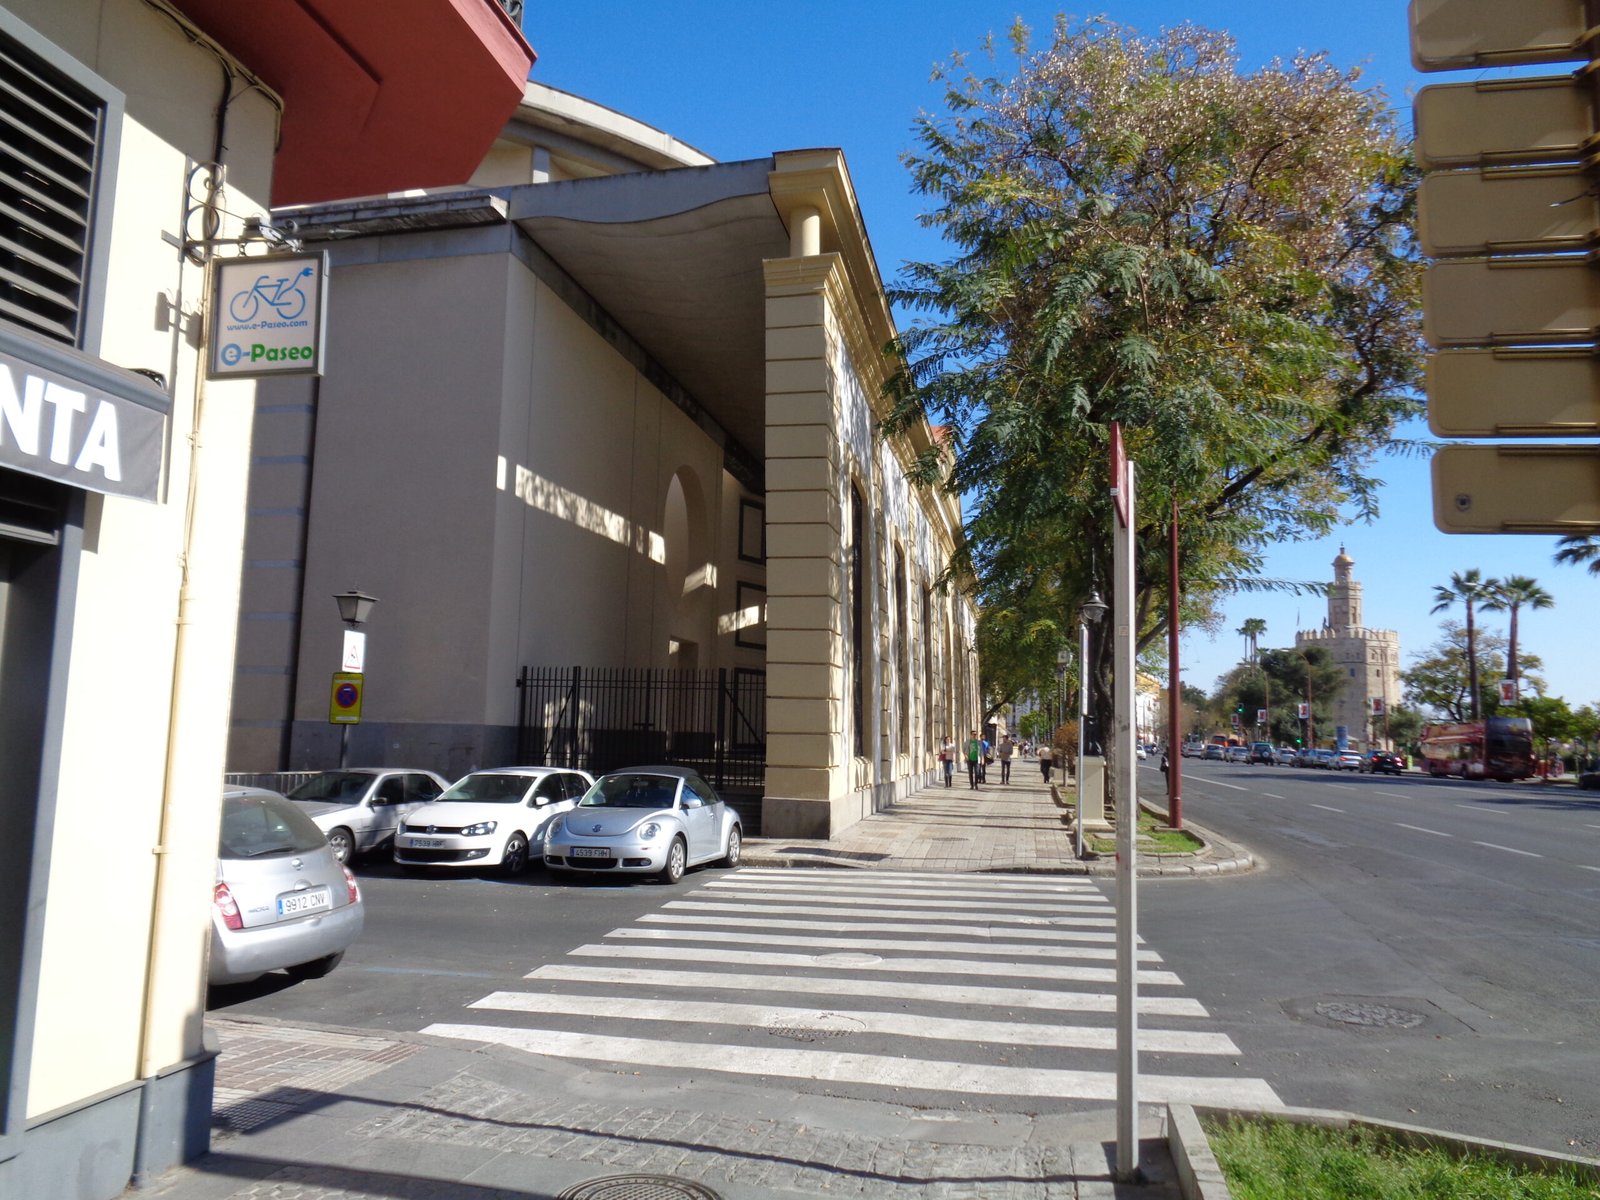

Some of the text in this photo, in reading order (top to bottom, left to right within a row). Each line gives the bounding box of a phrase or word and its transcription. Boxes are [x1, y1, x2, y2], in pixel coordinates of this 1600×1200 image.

[226, 320, 309, 331] www.e-Paseo.com
[220, 343, 313, 366] e-Paseo
[285, 896, 308, 912] 9912
[310, 893, 325, 907] CNV
